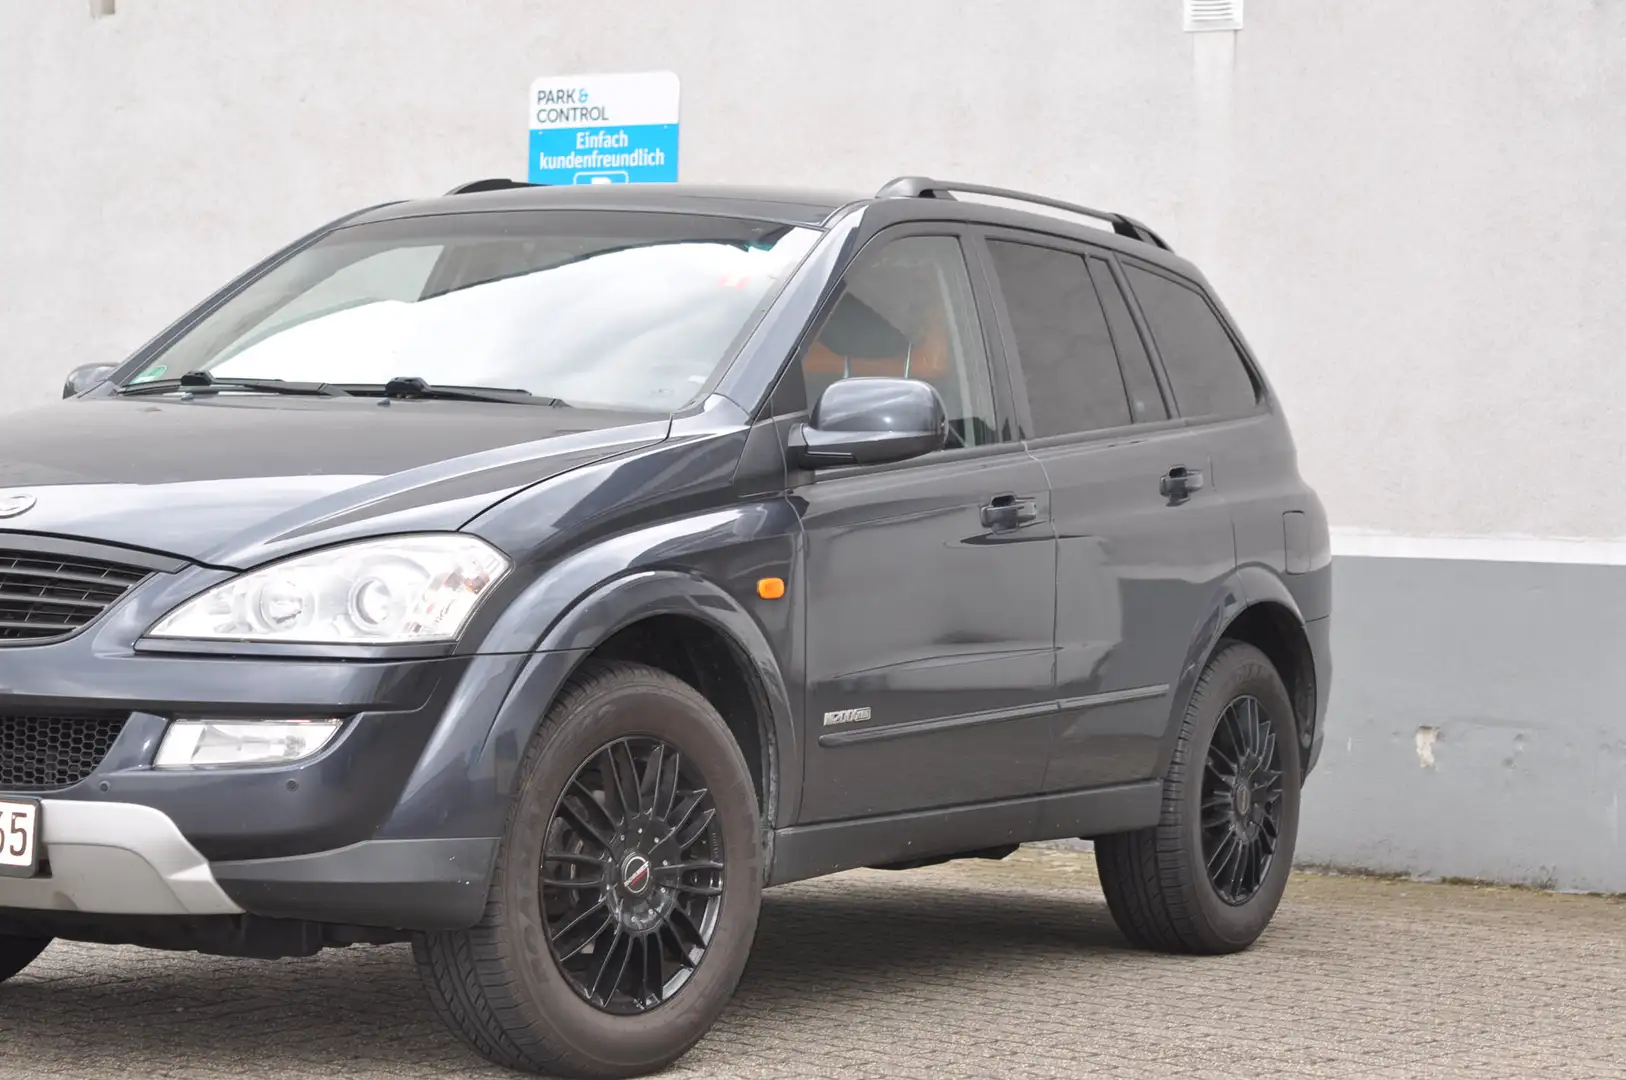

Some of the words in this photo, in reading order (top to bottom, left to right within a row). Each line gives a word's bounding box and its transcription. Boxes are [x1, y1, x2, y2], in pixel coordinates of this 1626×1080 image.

[537, 88, 576, 105] PARK
[536, 106, 609, 123] CONTROL
[576, 129, 629, 150] Einfach
[539, 148, 665, 170] kundenfreundlich
